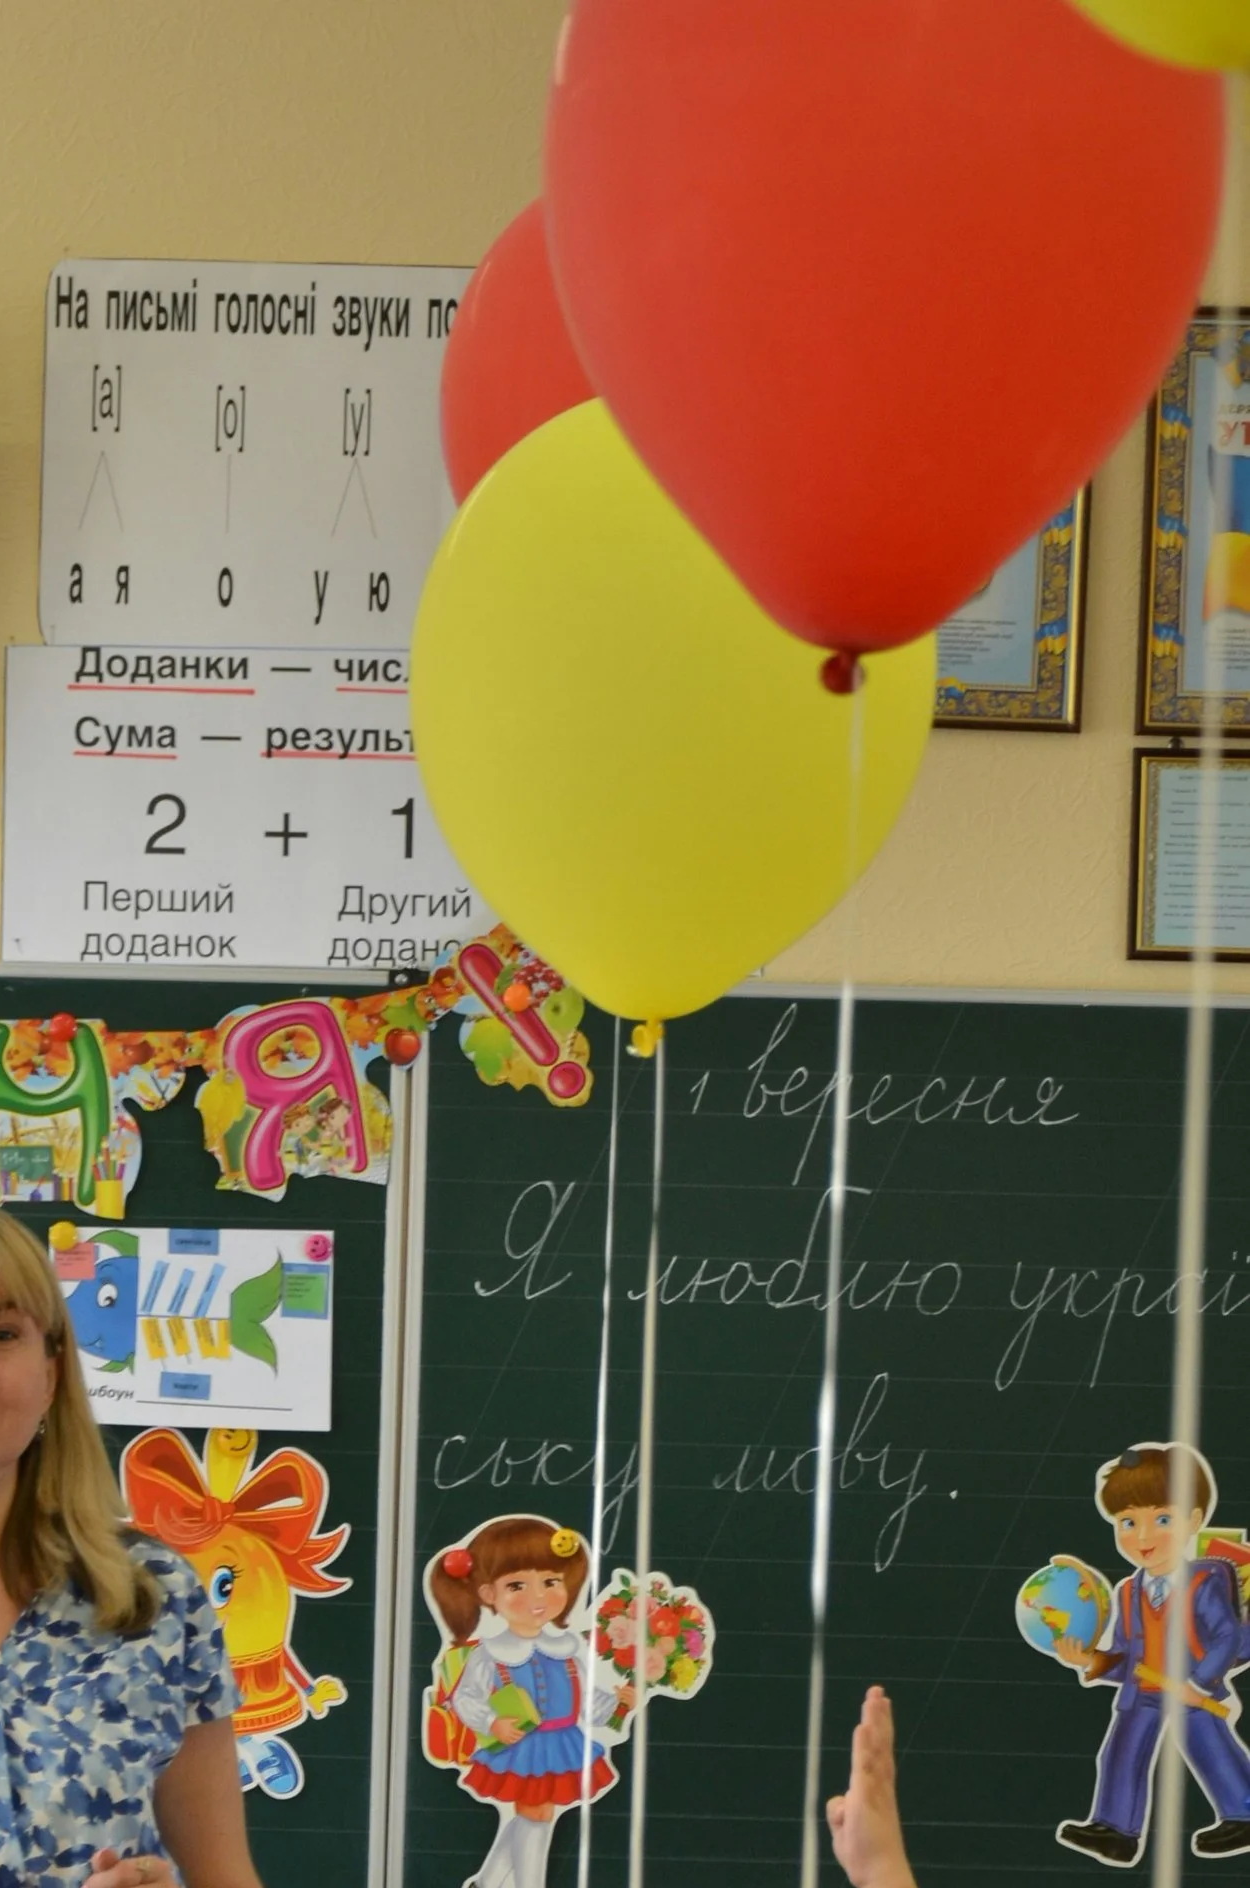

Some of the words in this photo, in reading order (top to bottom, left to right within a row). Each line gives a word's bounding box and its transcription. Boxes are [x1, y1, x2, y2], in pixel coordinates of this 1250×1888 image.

[55, 276, 90, 331] На
[106, 278, 198, 333] письмі
[214, 281, 316, 336] голосні
[332, 297, 410, 352] звуки
[68, 562, 84, 604] а
[115, 564, 130, 605] я
[218, 566, 233, 608] о
[314, 570, 329, 625] у
[369, 570, 391, 613] ю
[74, 646, 250, 683] Доданки
[333, 656, 410, 684] чис
[74, 715, 177, 755] Сума
[144, 793, 188, 855] 2
[391, 797, 416, 859] 1
[83, 880, 235, 920] Перший
[338, 884, 472, 926] Другий
[80, 928, 238, 963] доданок
[690, 1070, 710, 1113] 1
[742, 1003, 1079, 1185] вересня
[475, 1181, 575, 1299] Я
[628, 1185, 963, 1315] люблю
[433, 1433, 640, 1555] ську
